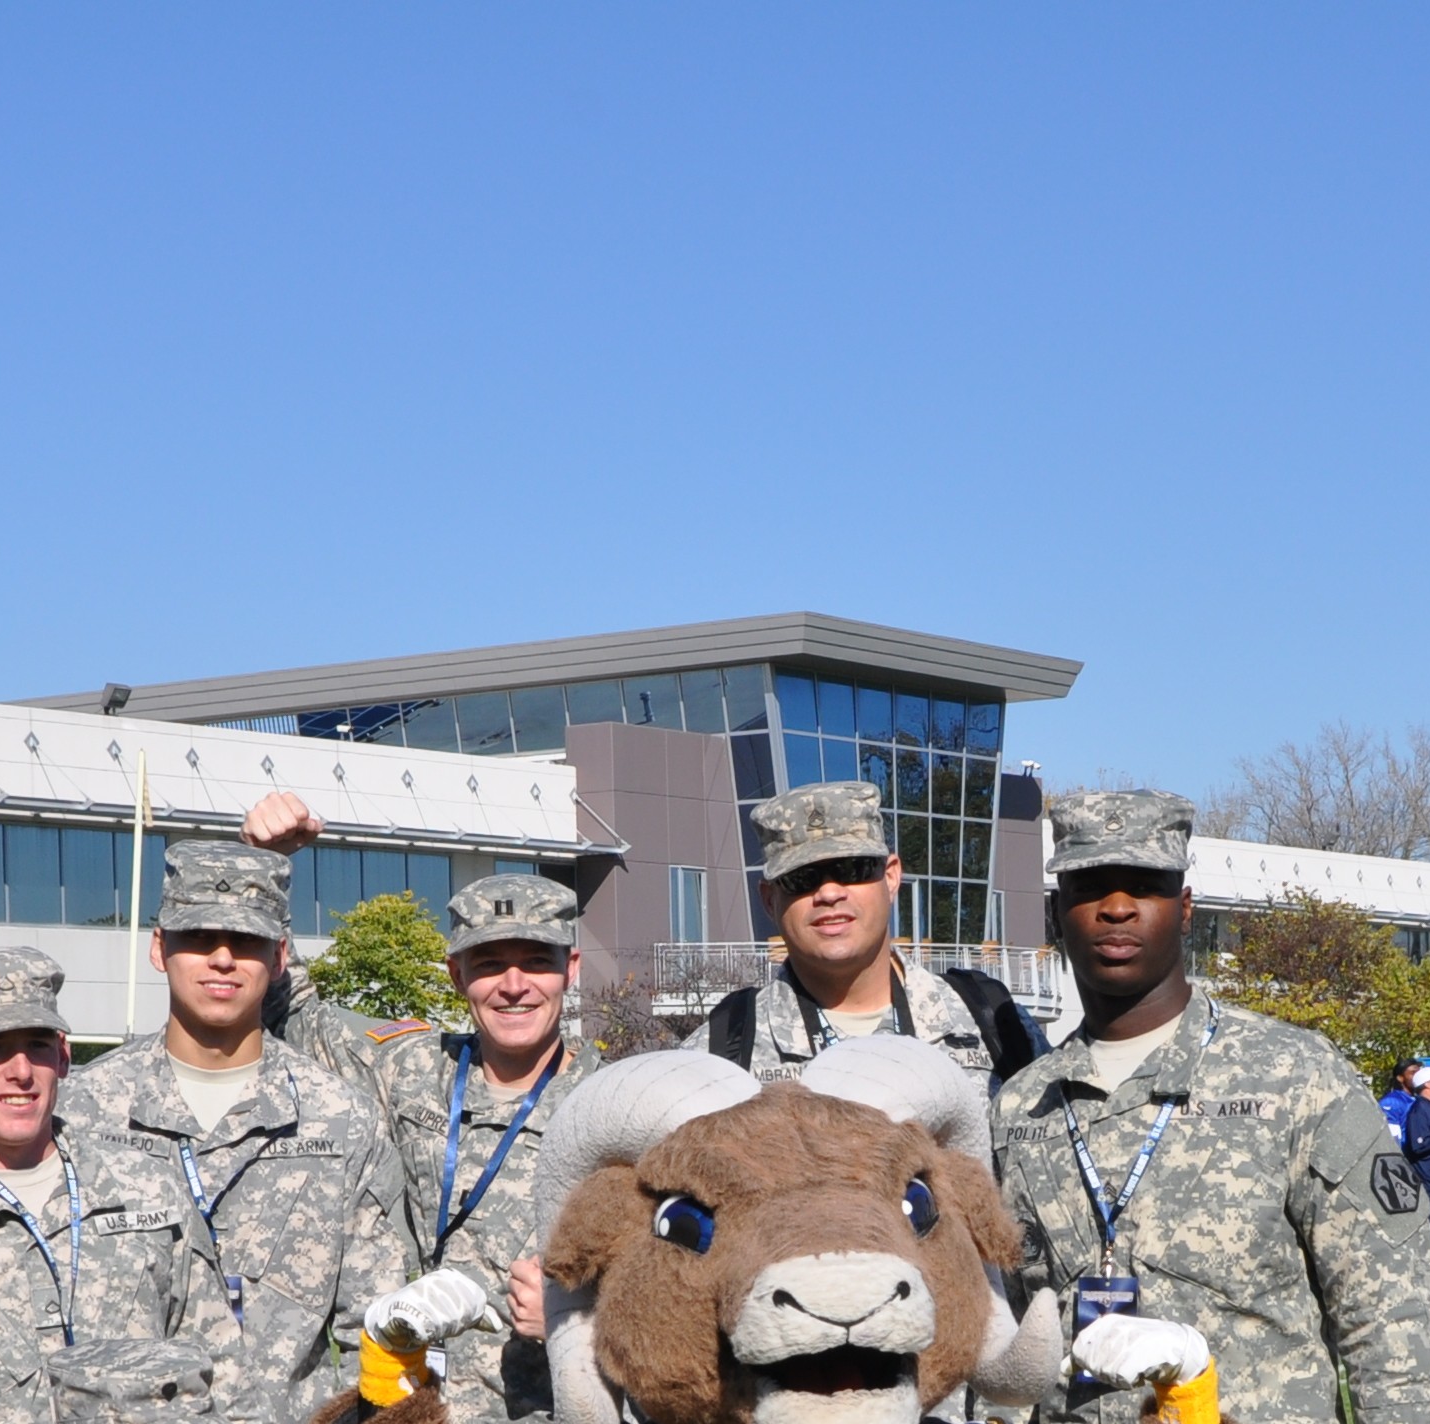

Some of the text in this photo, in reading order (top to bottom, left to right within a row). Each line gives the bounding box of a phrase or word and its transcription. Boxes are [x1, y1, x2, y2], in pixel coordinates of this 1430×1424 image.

[1180, 1101, 1264, 1117] U.S. ARMY
[1006, 1125, 1048, 1142] POLITE
[297, 1140, 335, 1154] ARMY
[1394, 1182, 1408, 1197] 3
[104, 1210, 170, 1230] U.S. ARMY
